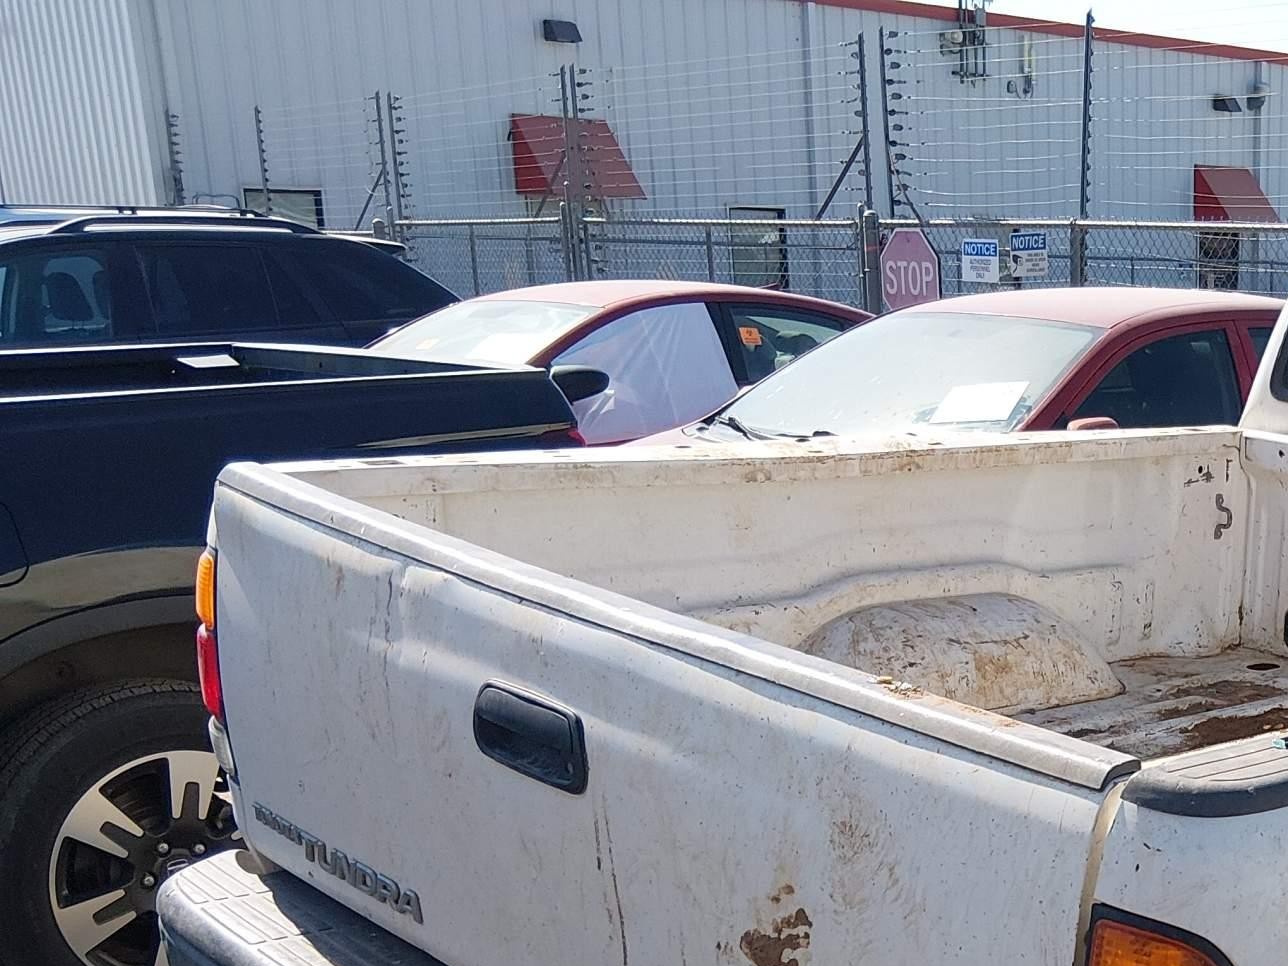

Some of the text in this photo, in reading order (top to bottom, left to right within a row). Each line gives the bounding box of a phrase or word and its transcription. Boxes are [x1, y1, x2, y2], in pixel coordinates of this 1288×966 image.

[965, 243, 996, 255] NOTICE
[1012, 236, 1044, 249] NOTICE
[886, 261, 933, 296] STOP
[301, 831, 424, 925] TUNDRA
